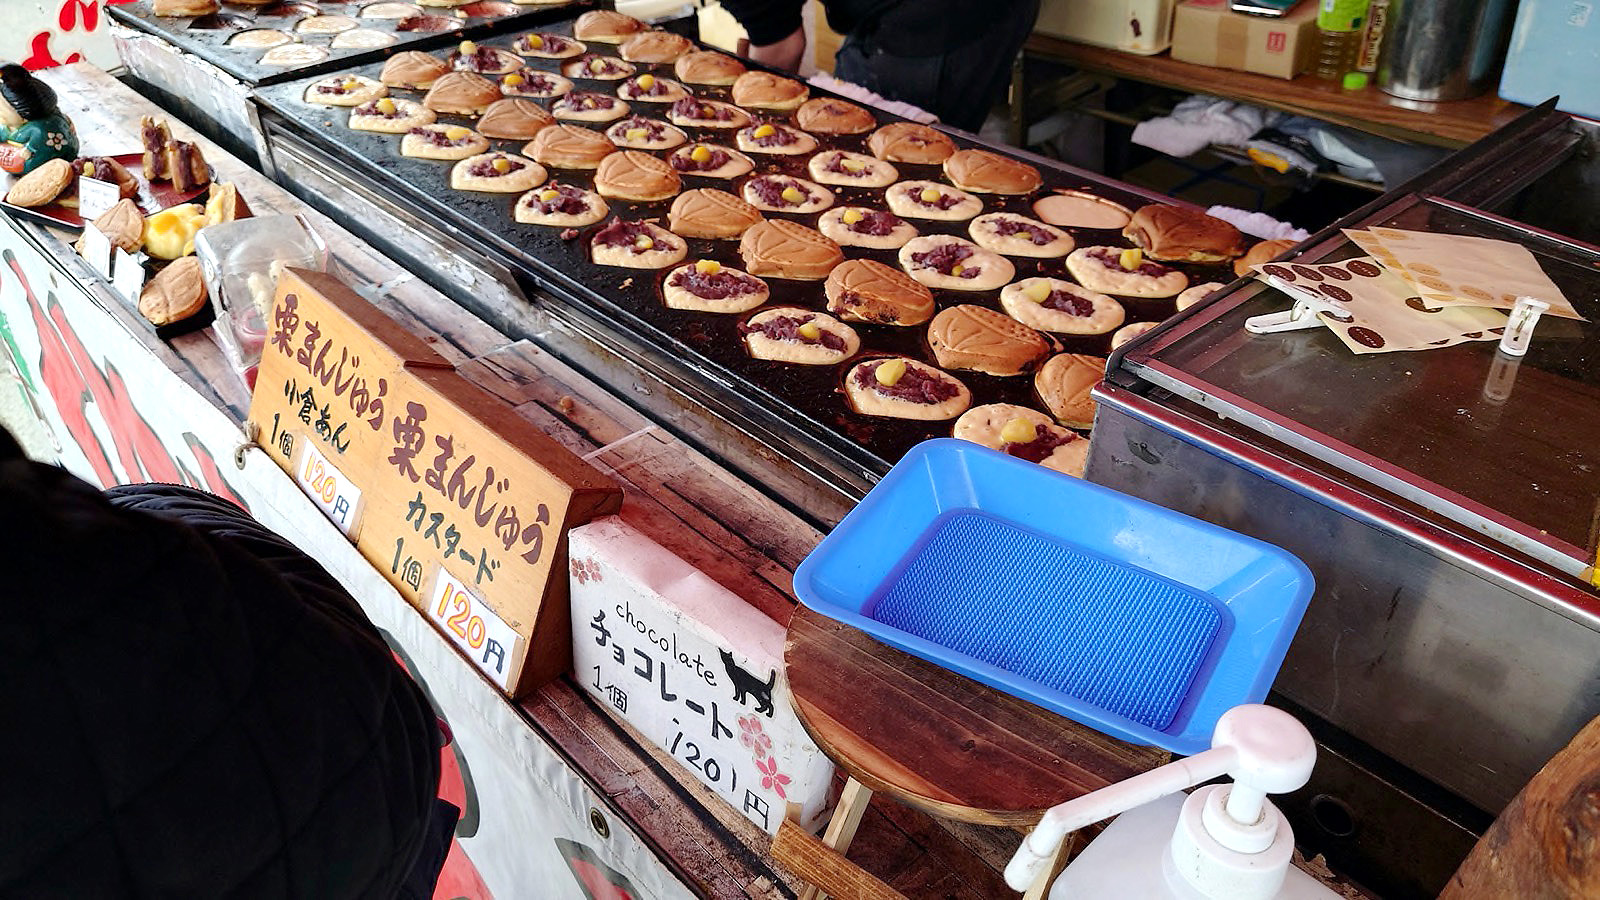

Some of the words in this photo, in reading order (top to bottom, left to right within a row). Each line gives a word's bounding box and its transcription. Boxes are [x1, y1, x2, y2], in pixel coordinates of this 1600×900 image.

[271, 293, 388, 431] 栗まんじゅう
[284, 377, 351, 454] 小倉あん
[271, 412, 294, 460] 1個
[304, 451, 350, 524] 120円
[387, 401, 550, 565] 栗まんじゅう
[405, 491, 501, 585] カスタード
[391, 537, 423, 592] 1個
[437, 583, 506, 675] 120円
[615, 601, 717, 687] chocolate
[590, 609, 733, 740] チョコレート
[592, 665, 628, 714] 1個
